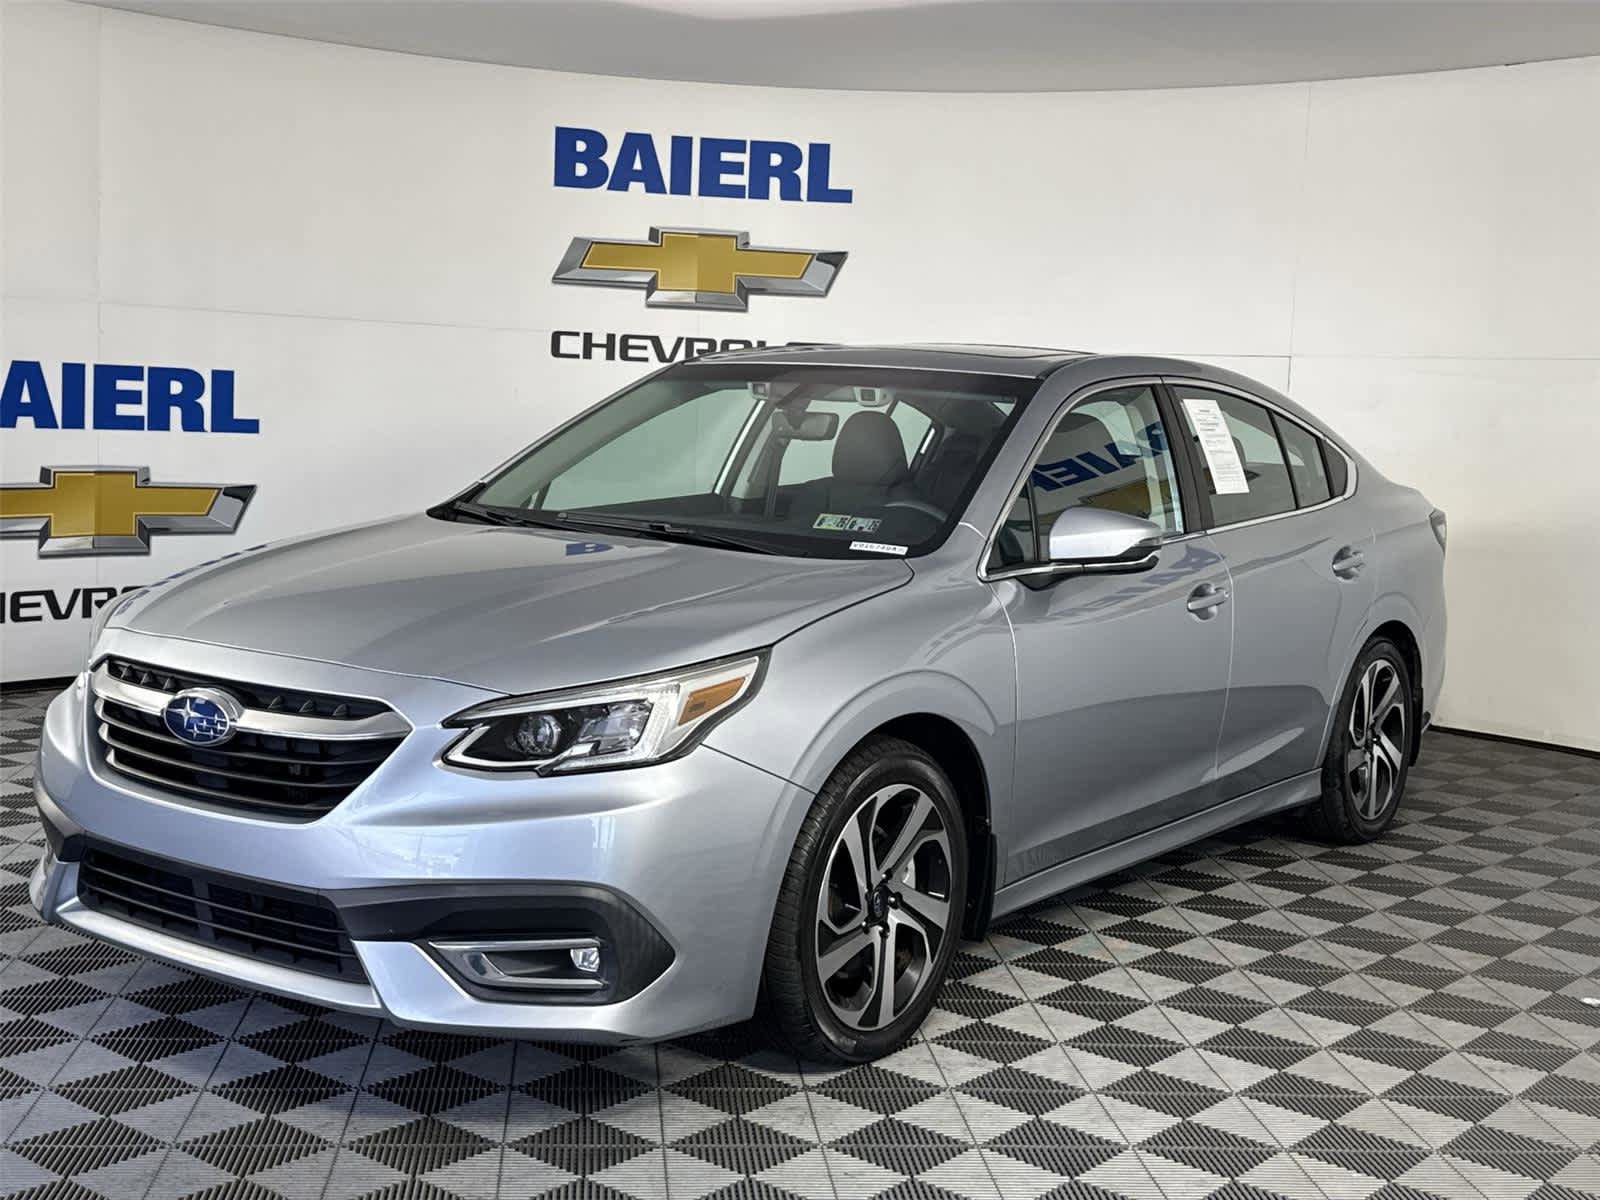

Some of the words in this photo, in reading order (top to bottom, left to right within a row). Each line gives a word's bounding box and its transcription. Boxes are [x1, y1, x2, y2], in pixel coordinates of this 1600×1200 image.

[553, 126, 853, 204] BAIERL
[551, 330, 842, 363] CHEVR
[0, 360, 260, 434] AIERL
[0, 586, 148, 624] EVR
